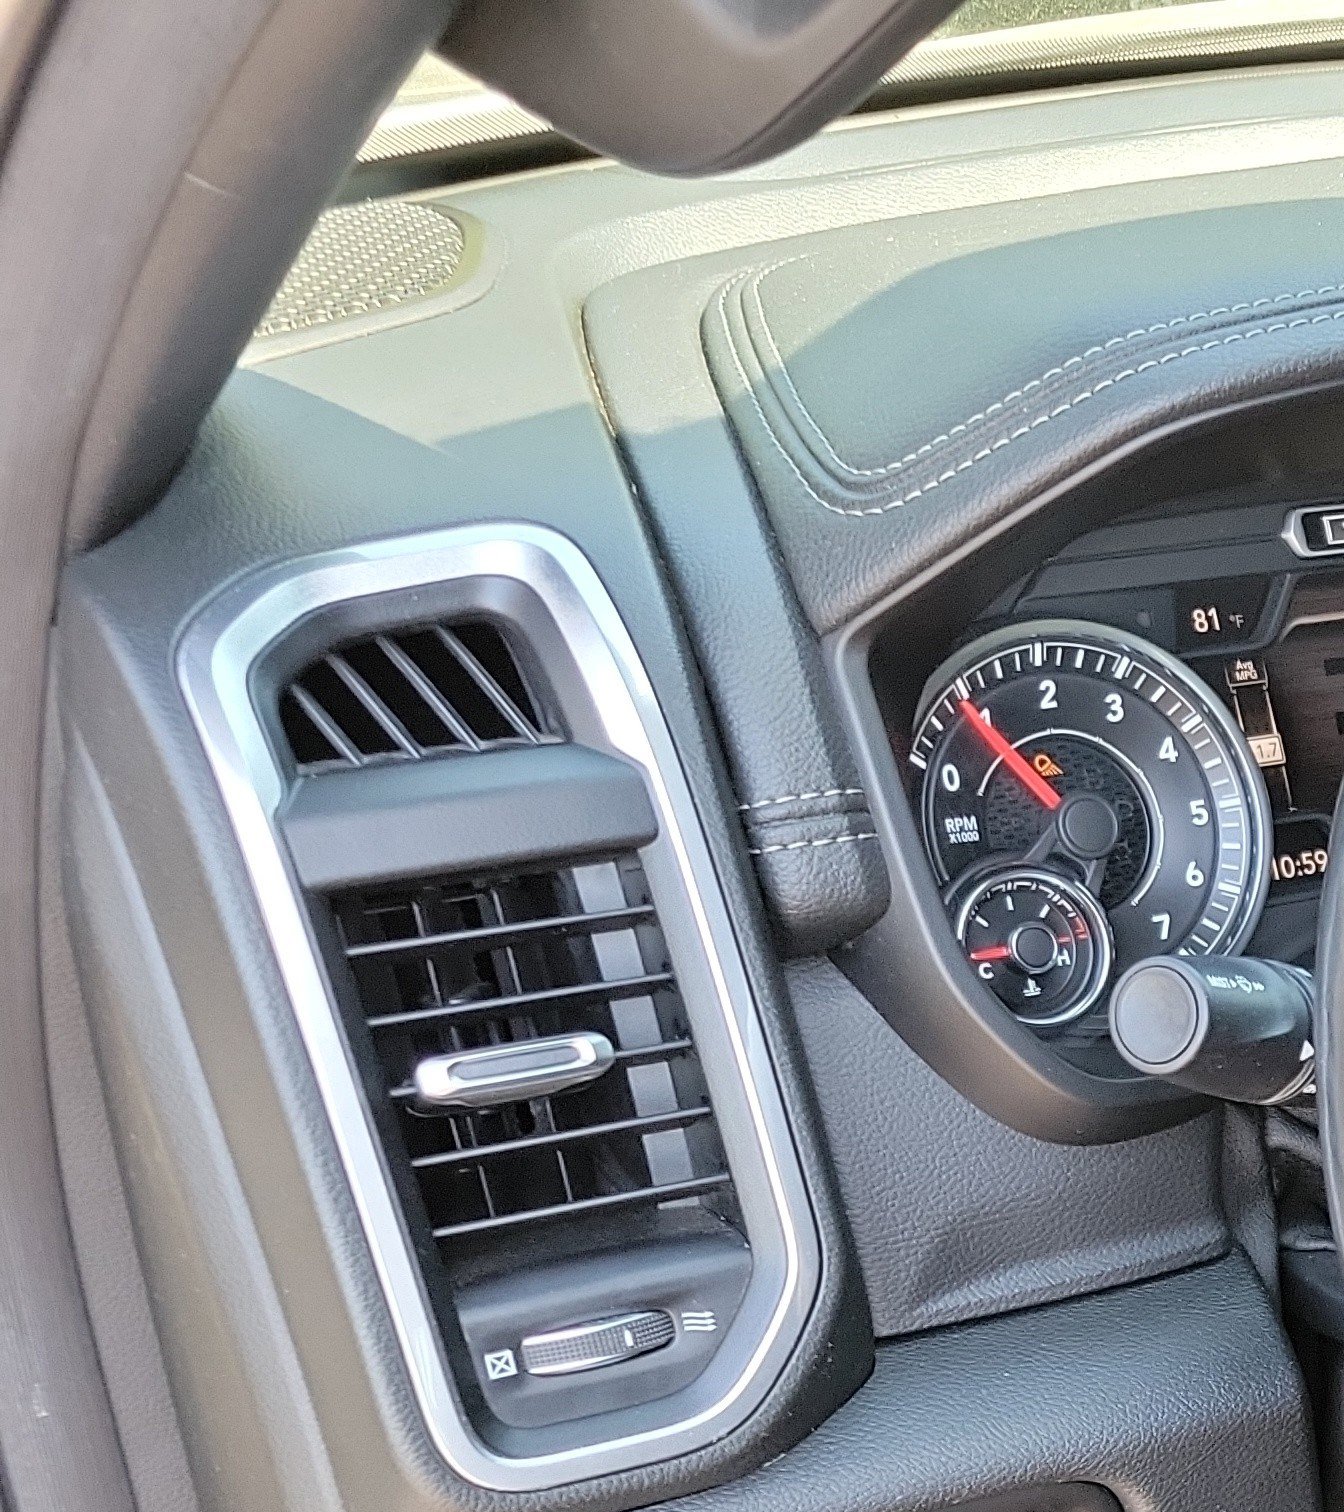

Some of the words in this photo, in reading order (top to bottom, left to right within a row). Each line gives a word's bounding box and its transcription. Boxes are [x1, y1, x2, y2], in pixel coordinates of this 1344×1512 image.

[1192, 606, 1221, 632] 81
[1235, 669, 1258, 681] MPG
[1038, 680, 1058, 710] 2
[1104, 693, 1124, 723] 3
[1158, 737, 1178, 763] 4
[942, 764, 960, 792] 0
[945, 815, 978, 833] RPM
[1189, 799, 1209, 826] 5
[1186, 861, 1204, 887] 6
[1272, 850, 1328, 880] 10:59
[1152, 913, 1170, 940] 7
[978, 962, 995, 980] C
[1057, 950, 1071, 967] H
